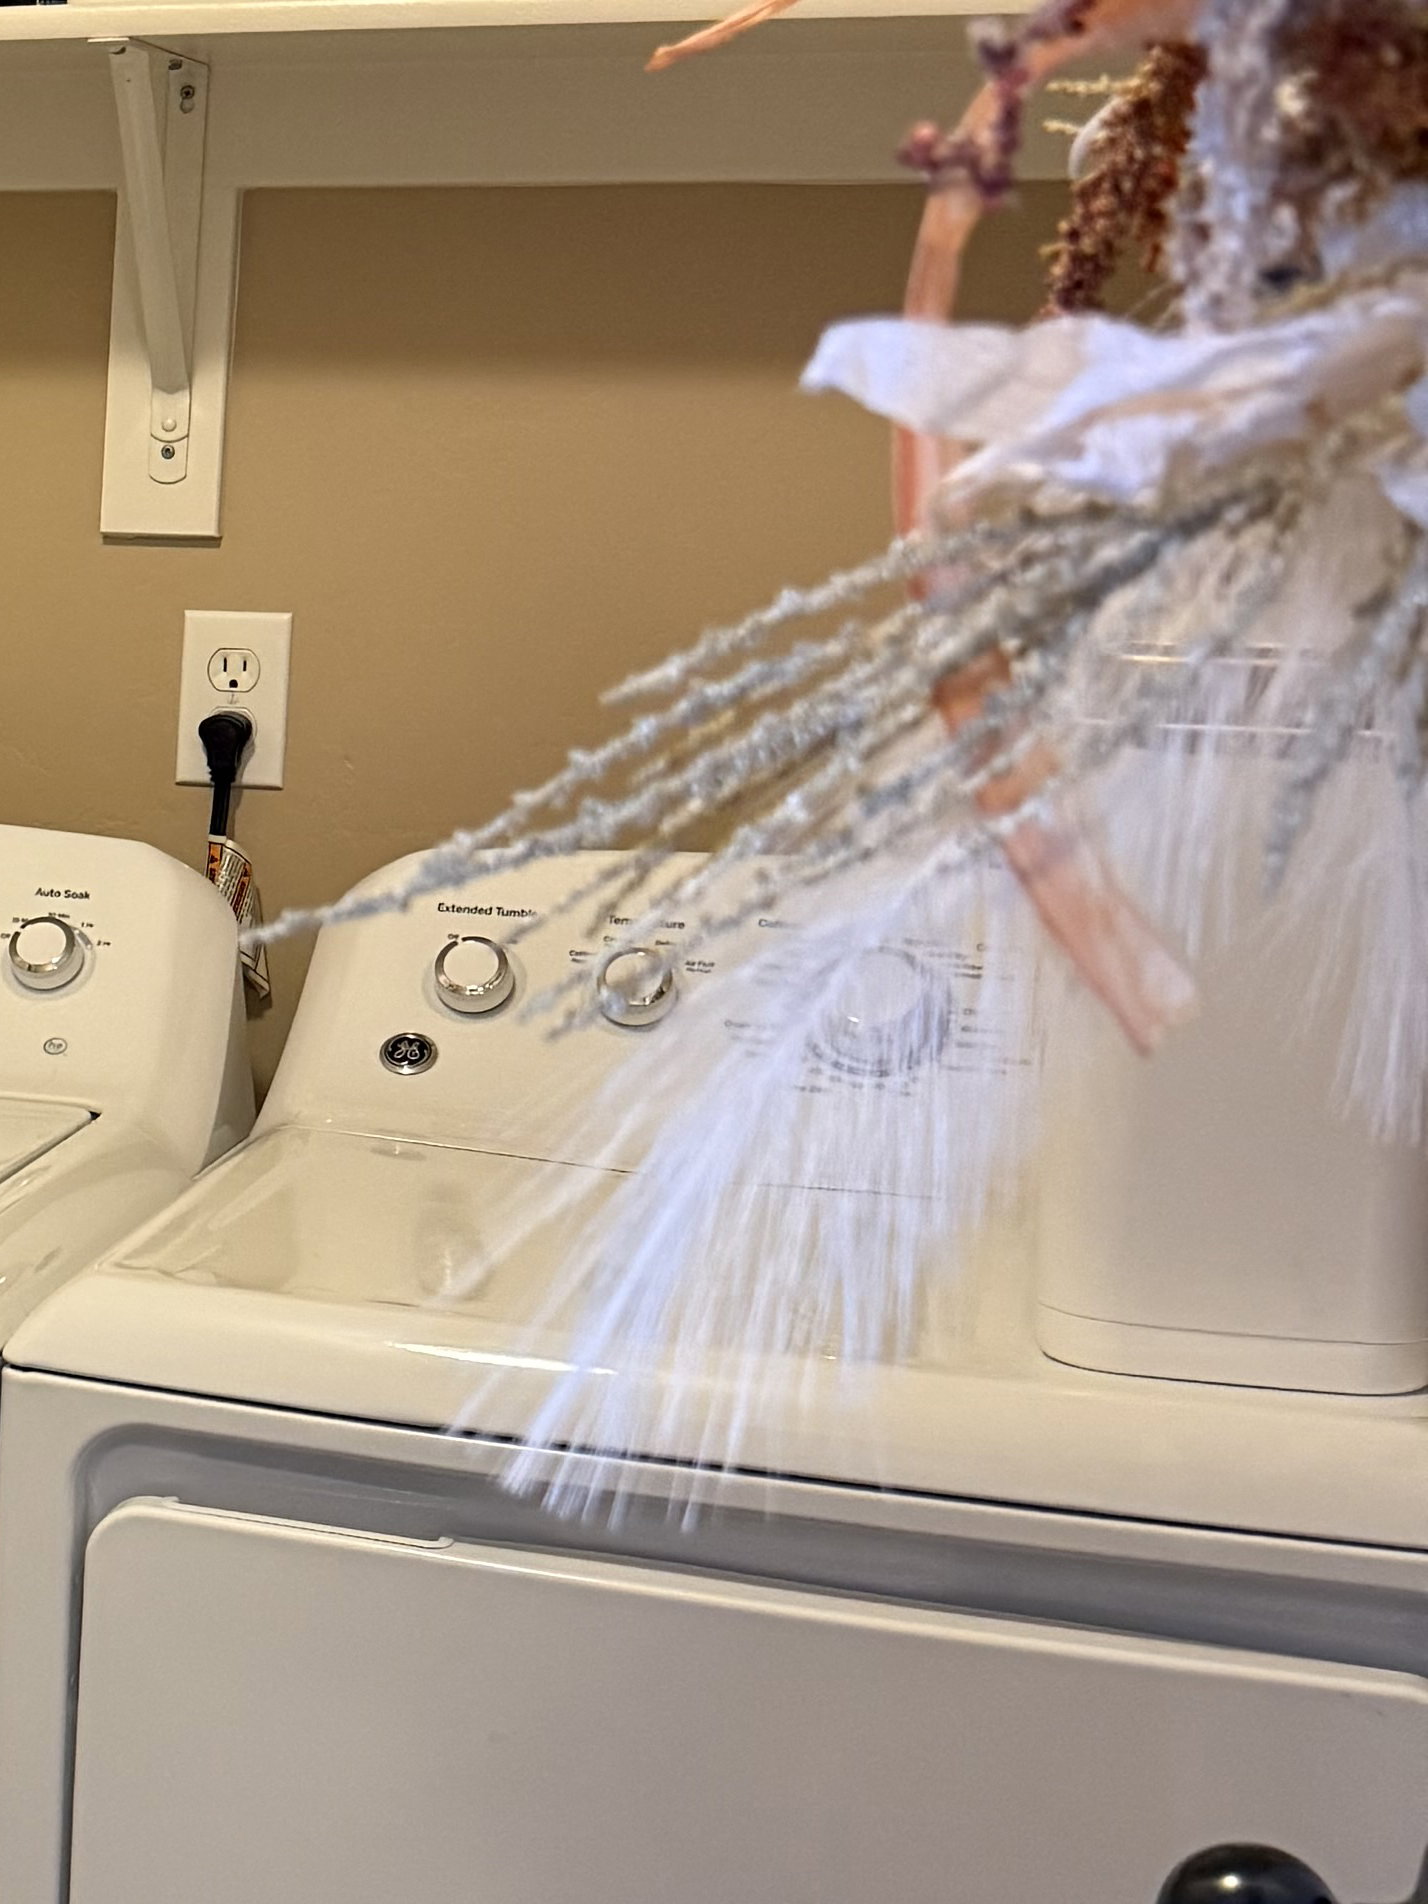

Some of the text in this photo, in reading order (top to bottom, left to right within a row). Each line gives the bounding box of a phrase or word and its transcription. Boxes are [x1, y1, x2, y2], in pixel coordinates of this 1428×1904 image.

[34, 888, 90, 900] Auto Soak
[437, 902, 493, 916] Extended
[608, 914, 686, 930] Temure
